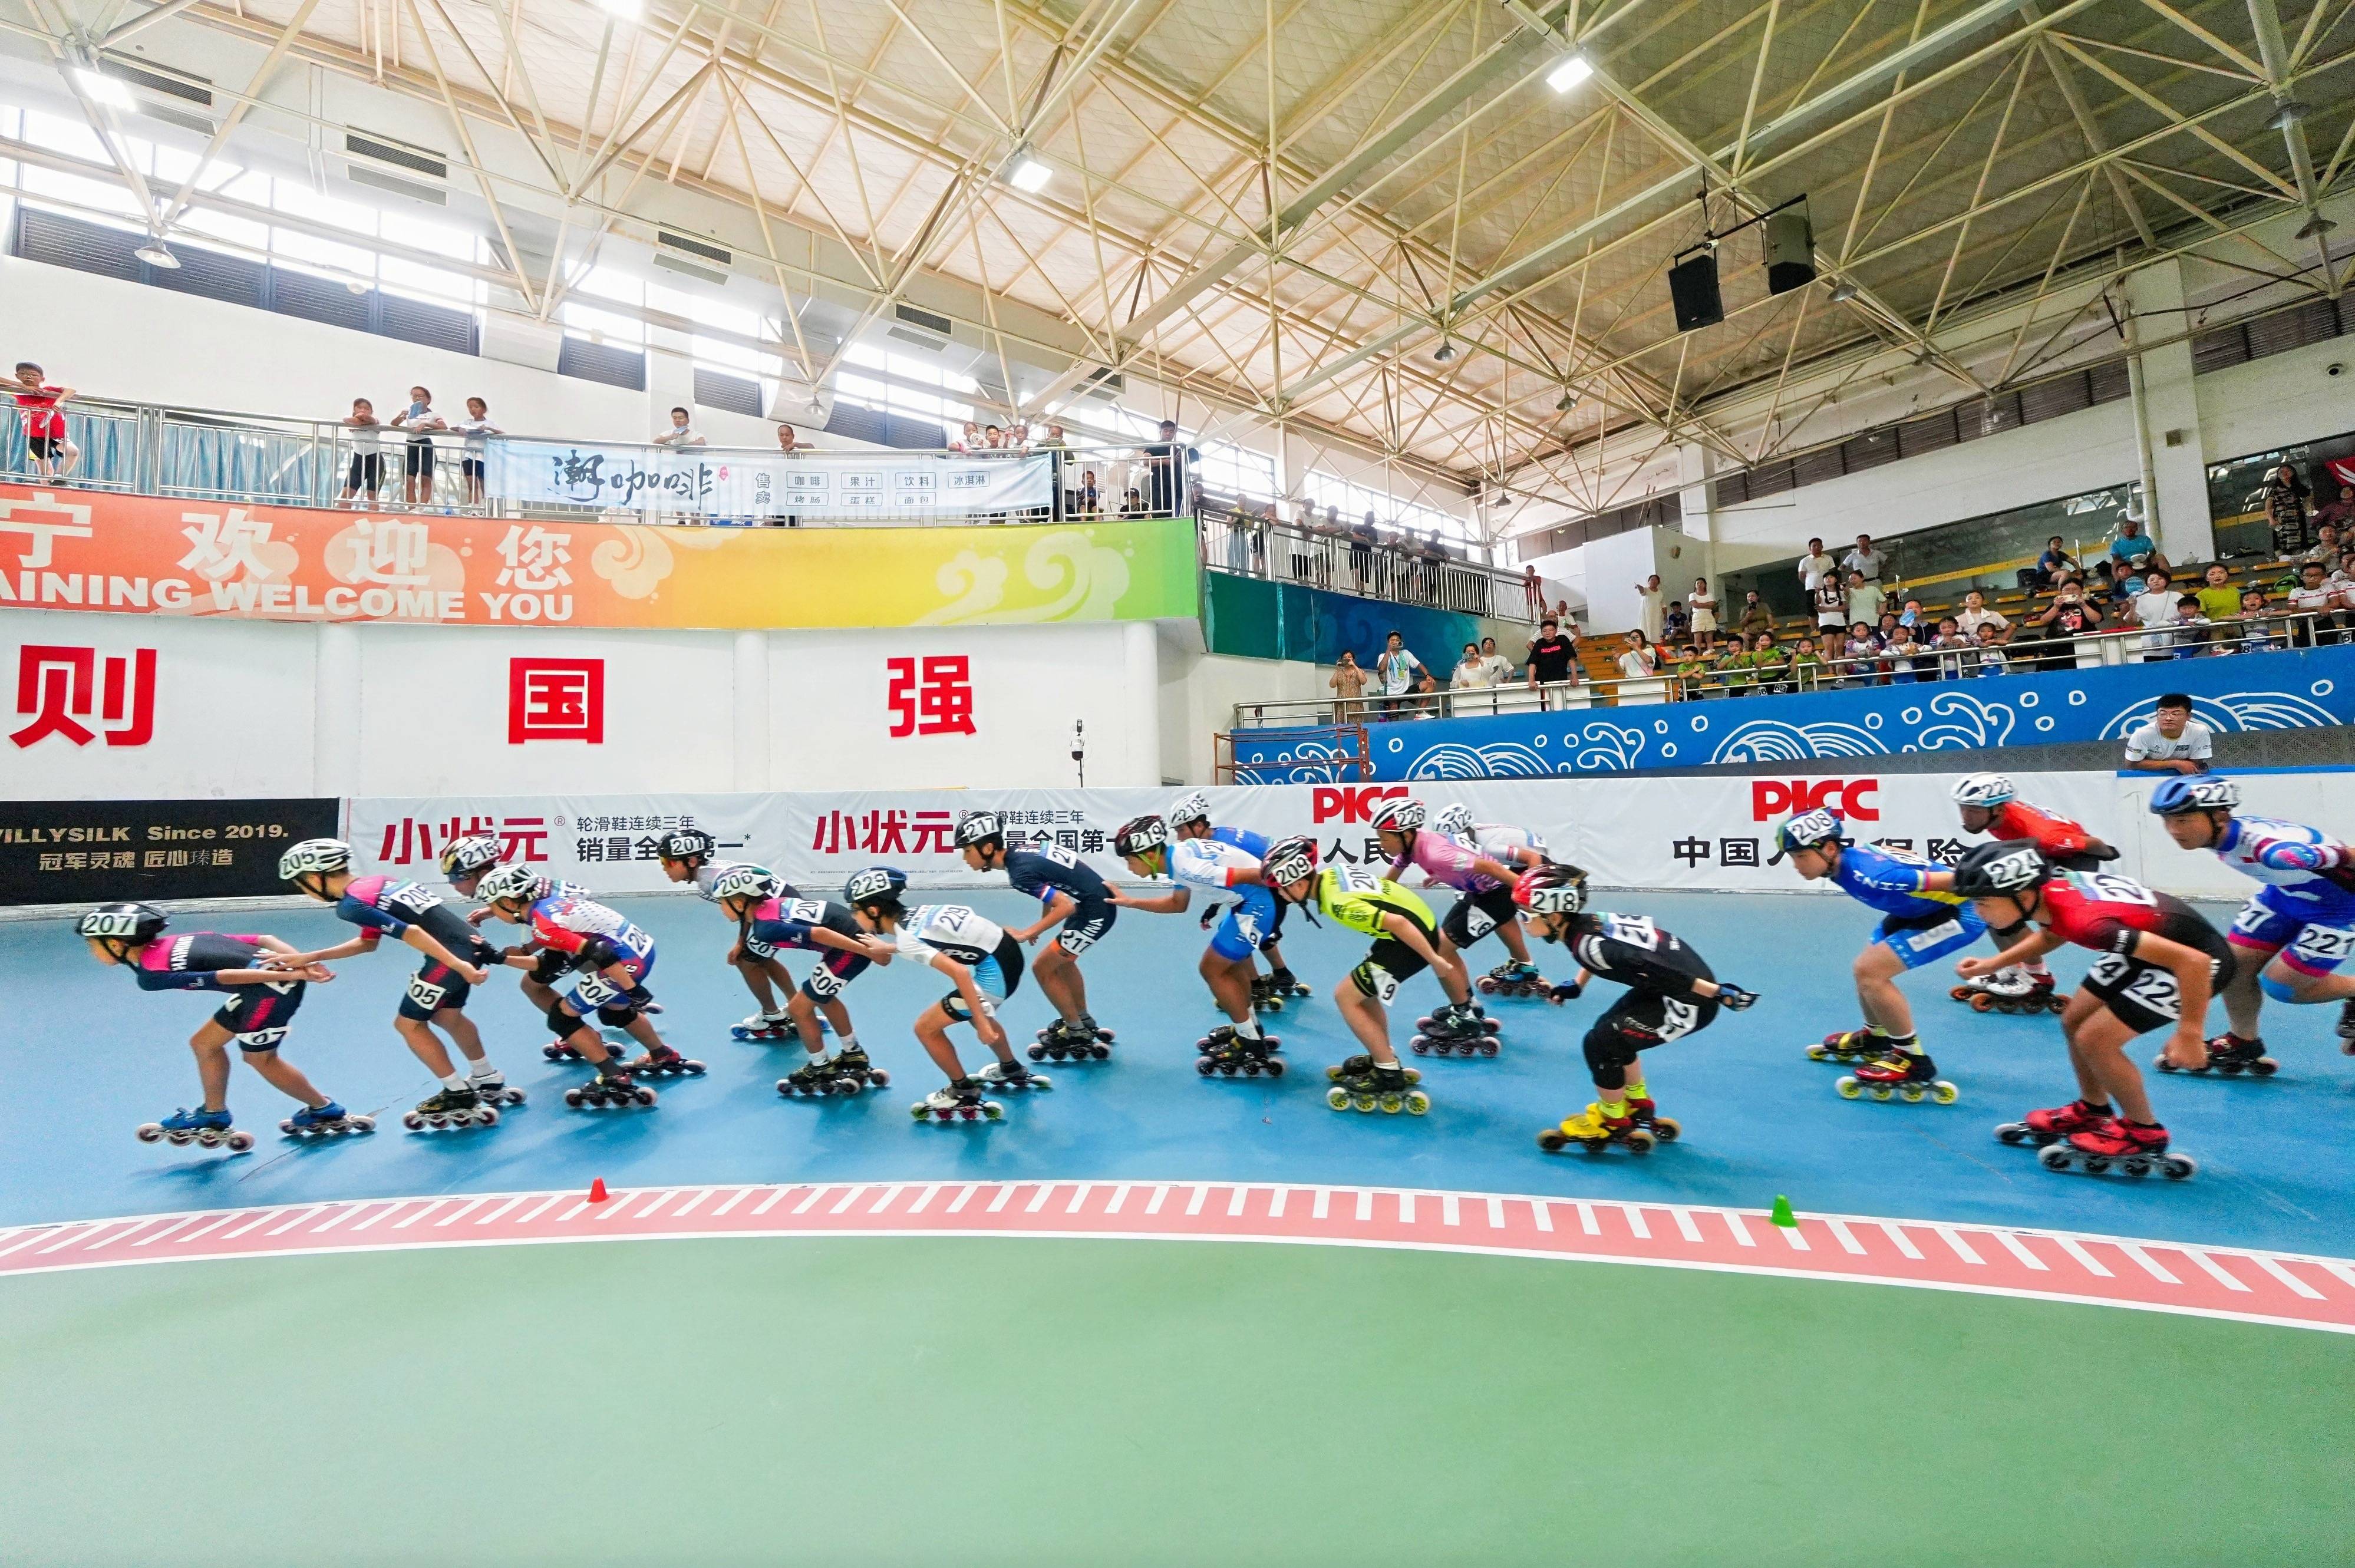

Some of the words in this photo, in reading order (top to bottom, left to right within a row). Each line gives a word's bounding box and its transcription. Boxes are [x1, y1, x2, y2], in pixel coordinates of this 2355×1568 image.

[756, 473, 771, 504] 售卖
[794, 476, 820, 486] 咖啡
[850, 476, 875, 487] 果汁
[904, 476, 929, 487] 饮料
[954, 475, 985, 486] 冰淇淋
[794, 496, 820, 504] 烤肠
[850, 496, 875, 504] 蛋糕
[904, 496, 929, 504] 面包
[209, 581, 465, 619] WELCOME
[479, 592, 573, 621] YOU
[9, 645, 157, 748] 则
[508, 657, 605, 744] 国
[887, 655, 978, 738] 强
[1752, 779, 1879, 821] PICC
[576, 815, 695, 832] 轮滑鞋连续三年
[965, 817, 995, 839] 217
[994, 810, 1084, 825] 滑鞋连续三年
[1792, 813, 1833, 839] 208
[0, 827, 131, 843] ILLYSILK
[147, 826, 216, 840] Since
[225, 824, 289, 839] 2019.
[812, 810, 954, 853] 小状元
[1133, 823, 1165, 850] 219
[672, 836, 705, 854] 201
[39, 851, 136, 871] 冠军灵魂
[1276, 859, 1312, 884] 209
[479, 876, 510, 898] 204
[720, 871, 754, 896] 206
[853, 872, 888, 896] 229
[1533, 890, 1576, 912] 218
[84, 915, 133, 935] 207
[939, 907, 970, 932] 229
[749, 938, 779, 958] 201
[410, 975, 437, 1005] 05
[579, 975, 614, 1003] 204
[812, 966, 843, 995] 206
